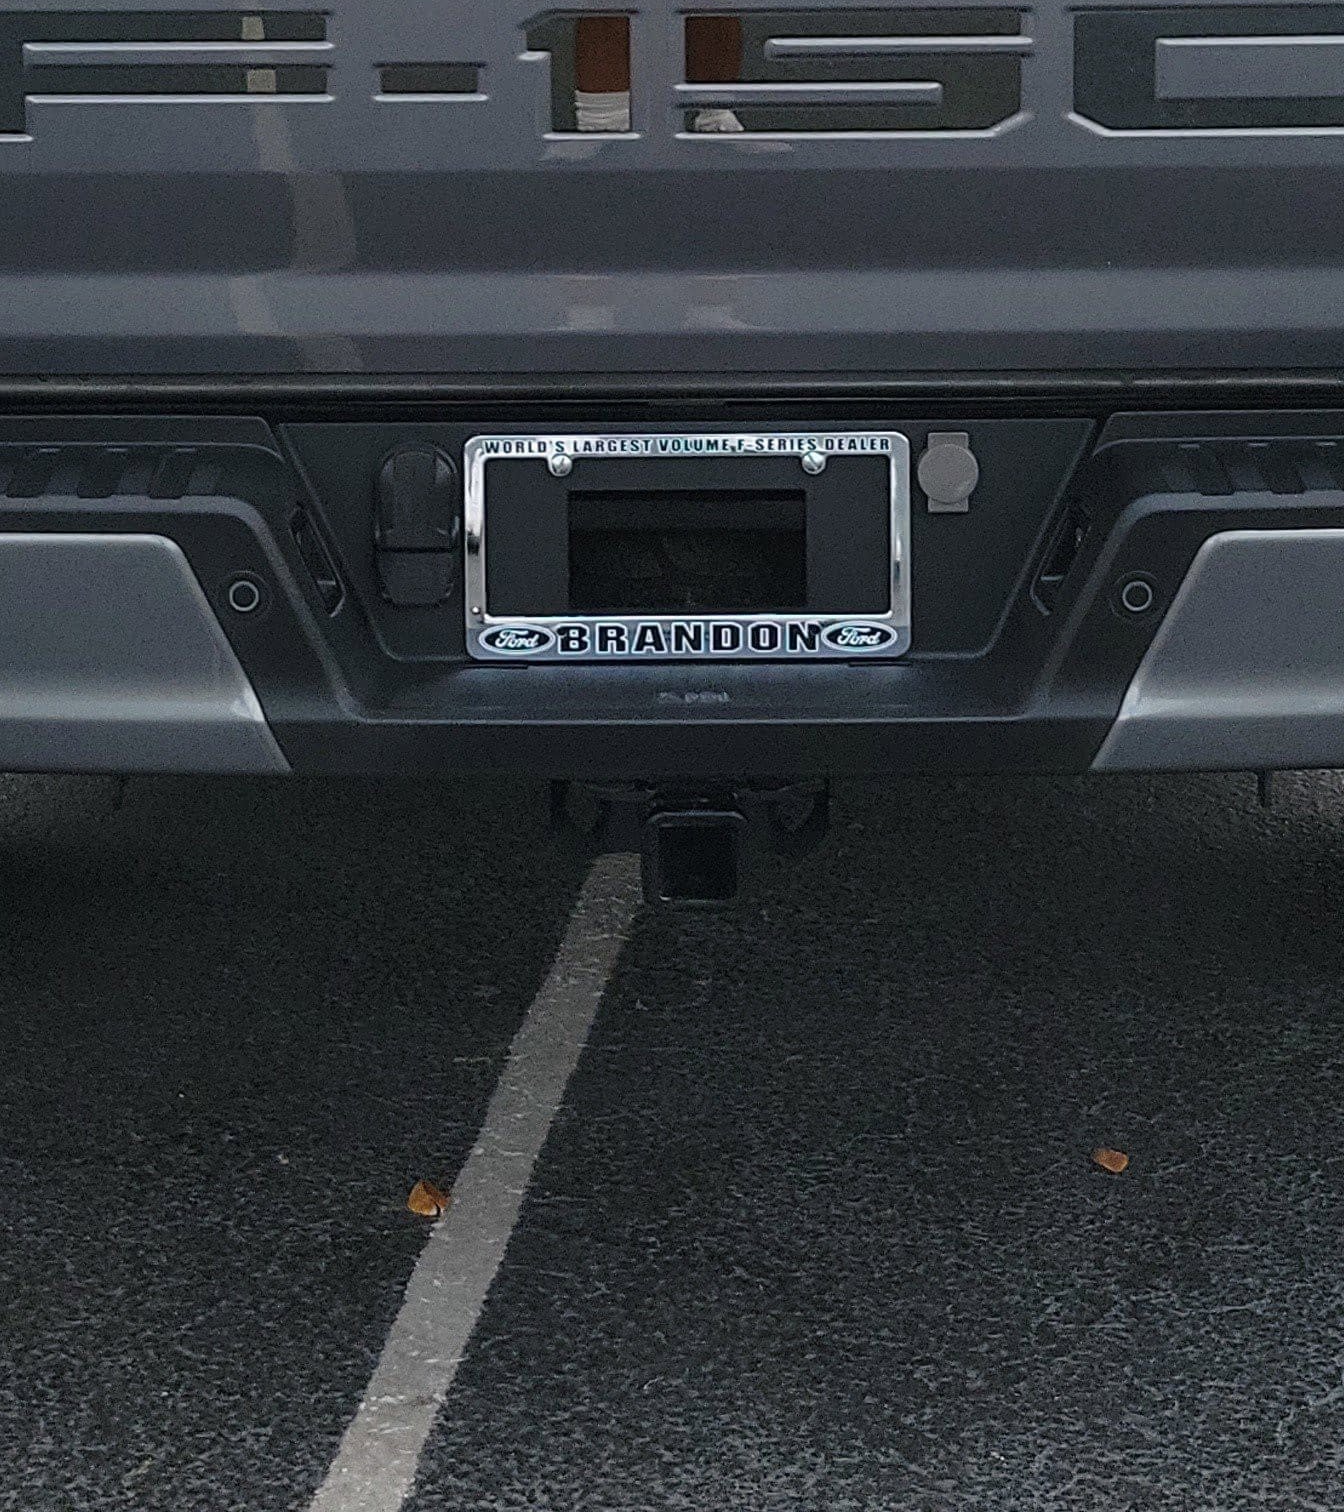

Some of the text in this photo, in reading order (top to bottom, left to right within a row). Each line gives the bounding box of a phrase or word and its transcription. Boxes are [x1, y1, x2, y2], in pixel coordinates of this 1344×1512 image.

[484, 438, 891, 454] WORLD'S LARGEST VOLUME F-SERIES DEALER
[494, 620, 882, 655] Ford BRANDON Ford
